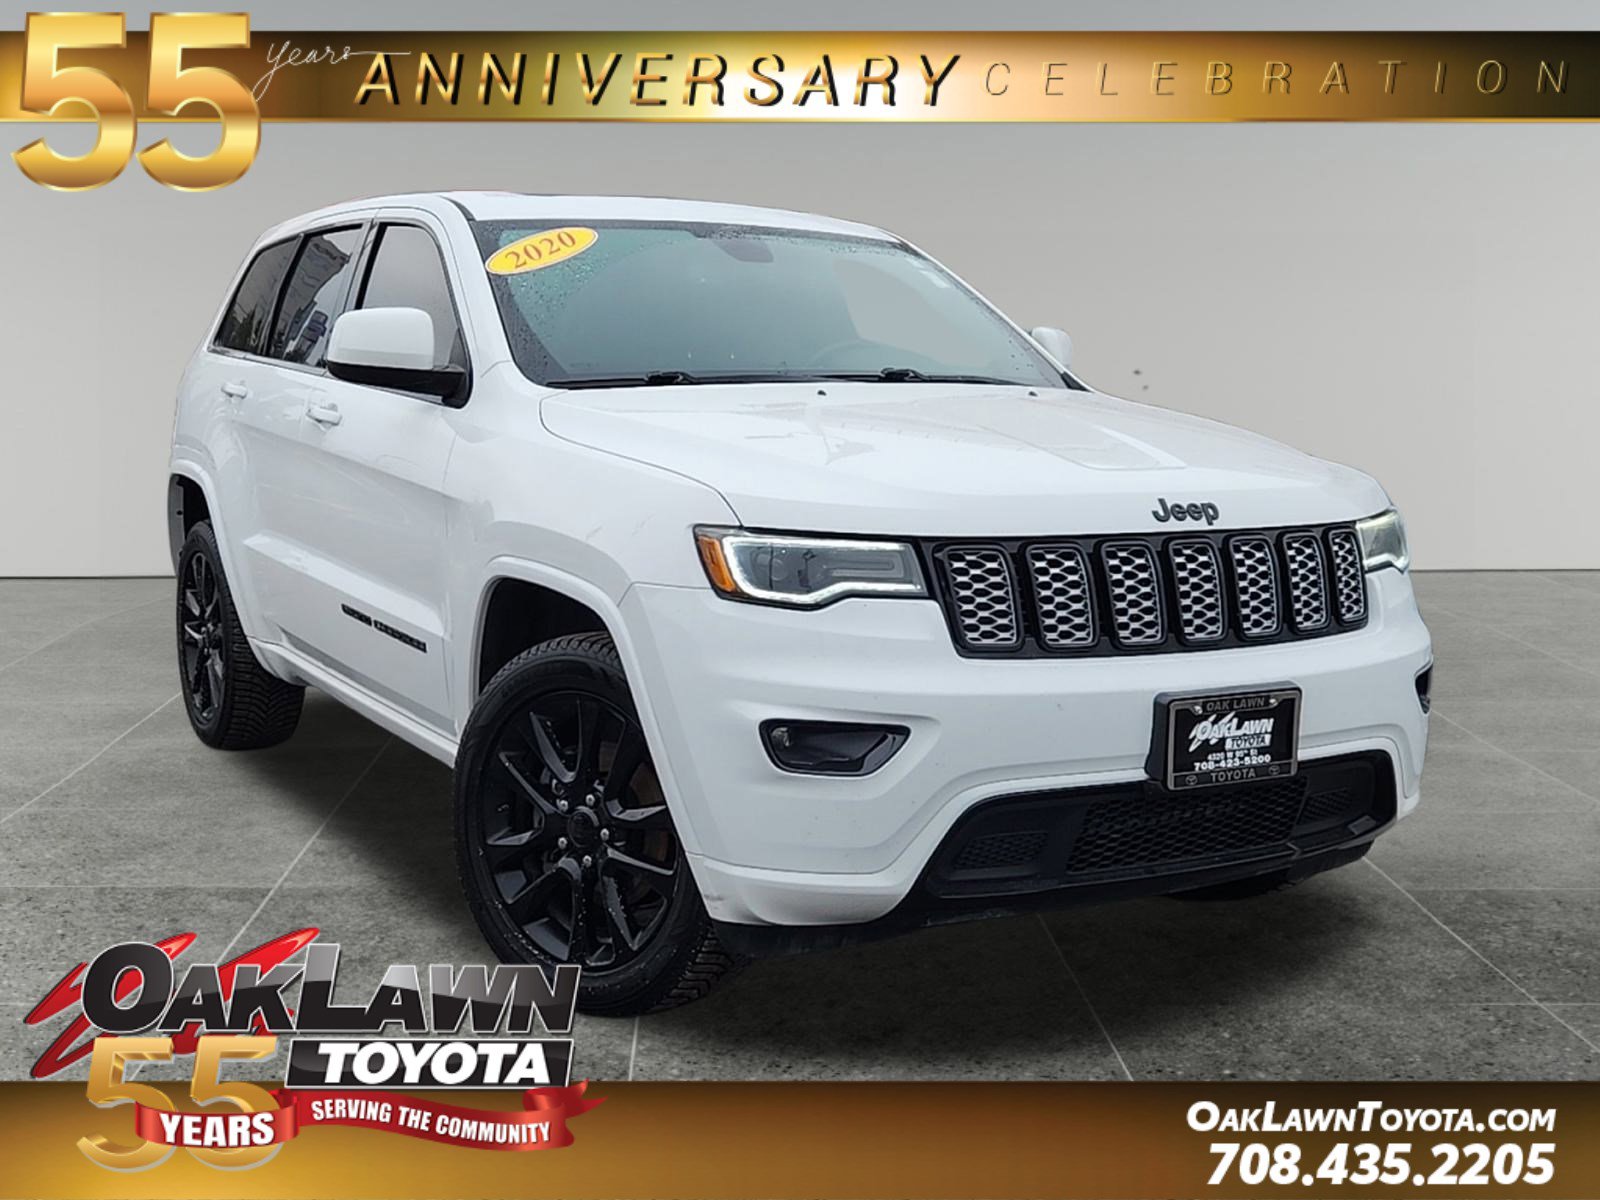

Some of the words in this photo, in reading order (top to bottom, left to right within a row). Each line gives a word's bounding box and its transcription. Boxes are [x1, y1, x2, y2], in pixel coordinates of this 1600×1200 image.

[505, 231, 576, 269] 2020
[1151, 498, 1219, 526] Jeep
[1206, 700, 1230, 711] OAK
[1233, 697, 1265, 709] LAWN
[1231, 735, 1267, 750] TOYOTA
[1194, 753, 1272, 772] 708-423-5200
[1210, 768, 1256, 782] TOYOTA
